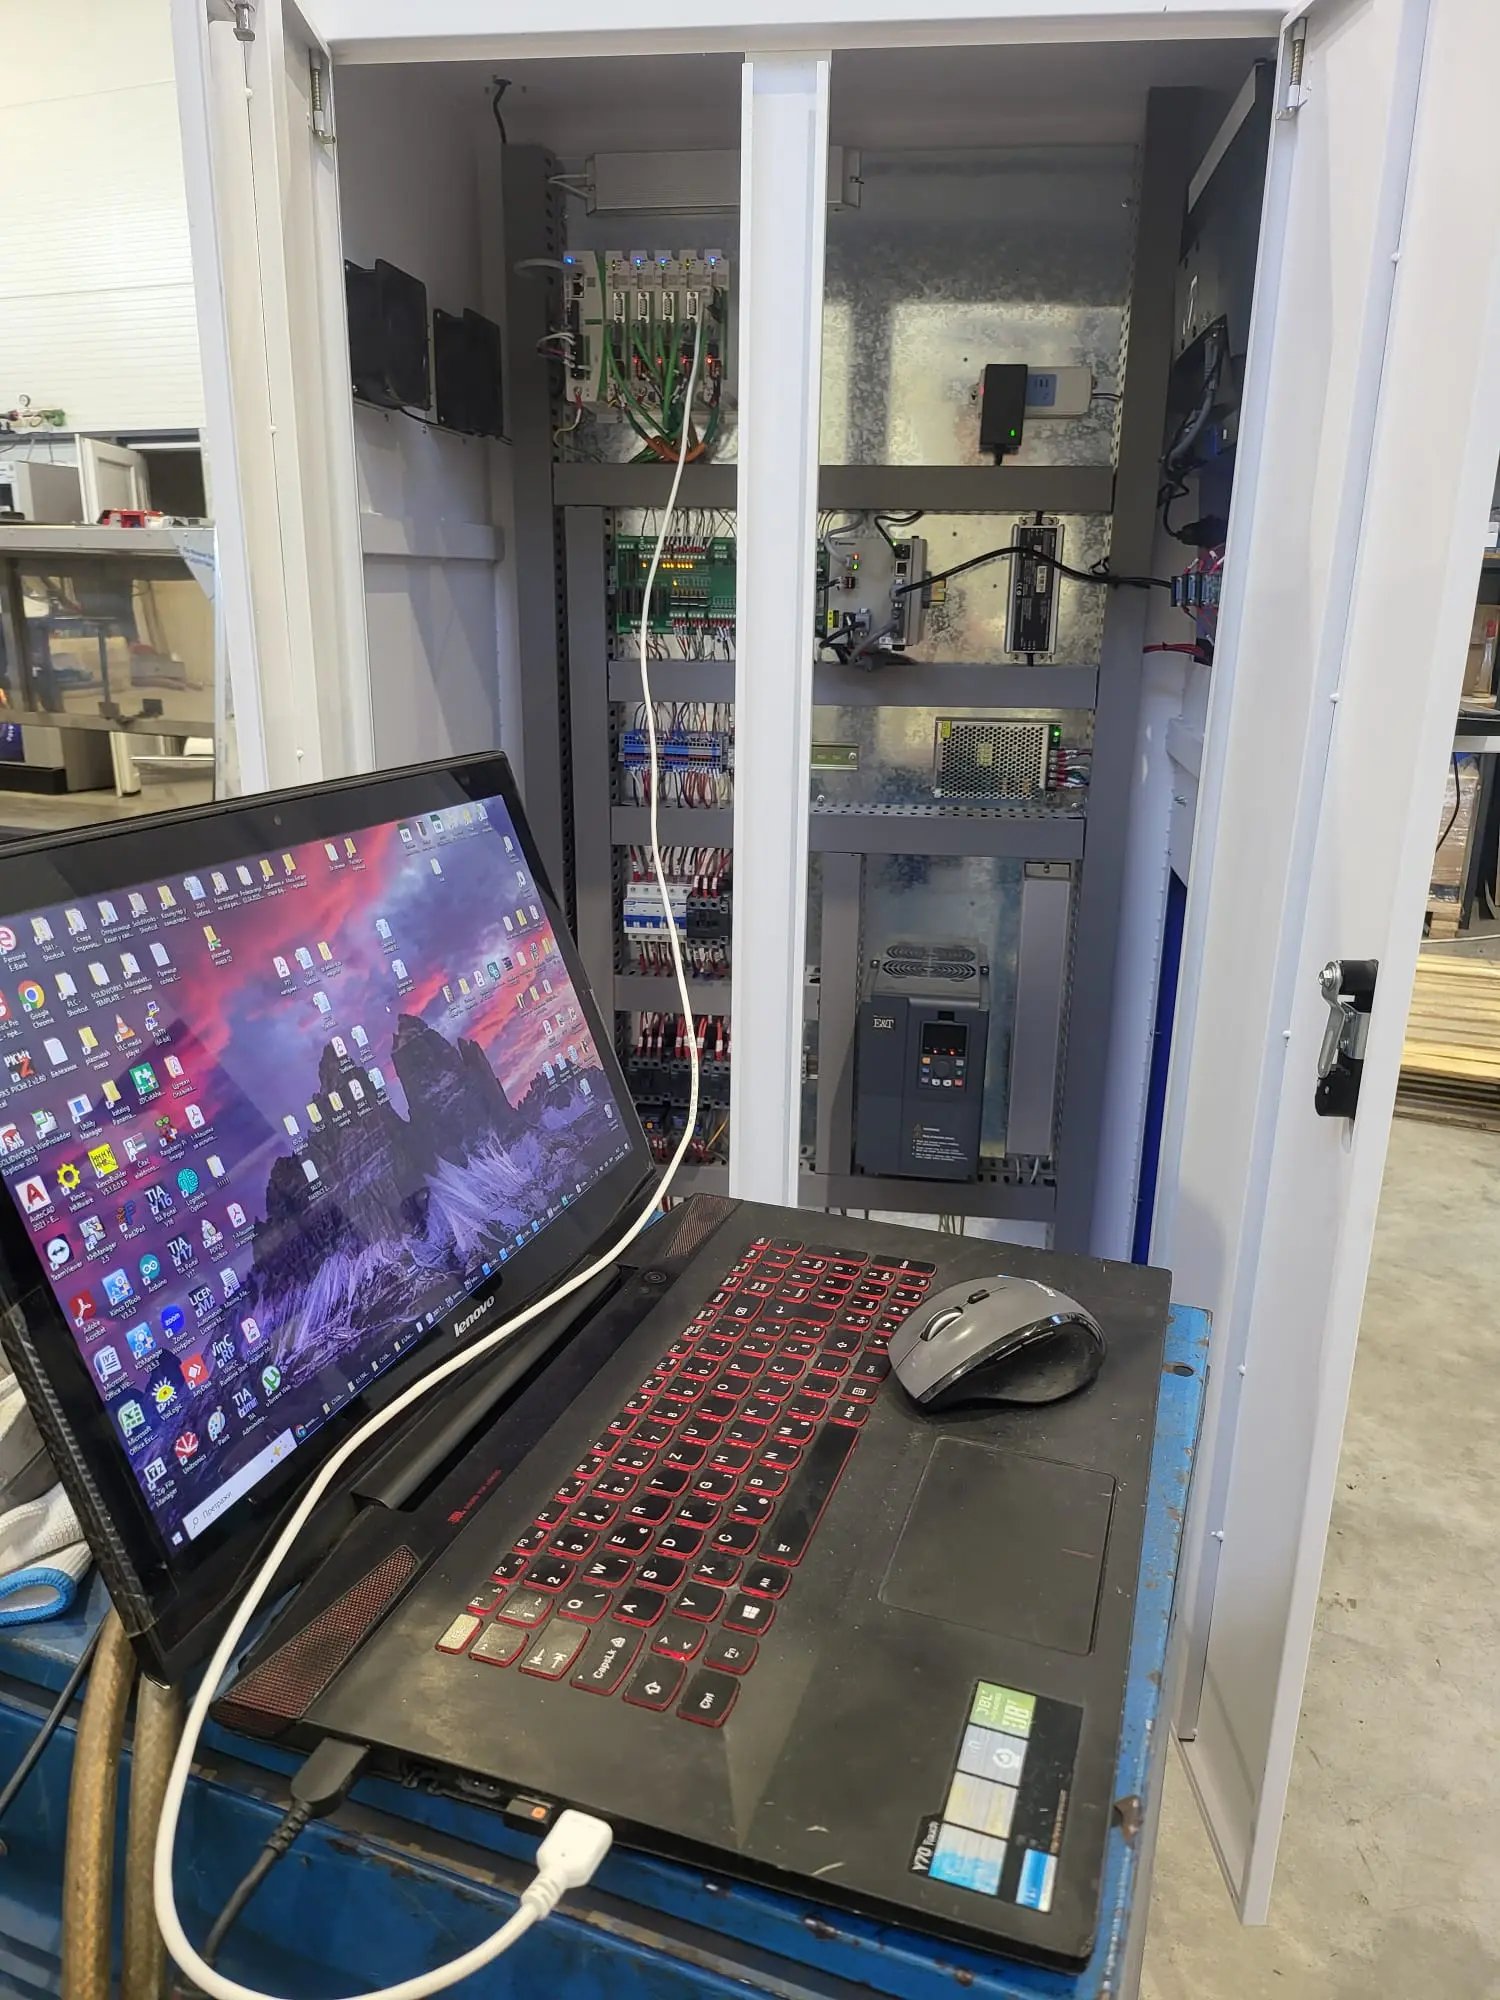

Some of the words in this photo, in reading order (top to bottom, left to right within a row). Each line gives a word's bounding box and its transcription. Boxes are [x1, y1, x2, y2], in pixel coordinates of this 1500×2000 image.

[30, 1010, 49, 1020] Google
[33, 1018, 55, 1028] Chrome
[145, 1186, 165, 1202] TIA
[29, 1206, 55, 1223] AutoCAD
[167, 1237, 188, 1255] TIA
[165, 1313, 180, 1326] zoom
[453, 1296, 495, 1337] lenovo
[669, 1344, 681, 1353] F12
[656, 1362, 667, 1370] F11
[641, 1379, 654, 1389] F10
[717, 1383, 729, 1391] O
[232, 1388, 251, 1406] TIA
[744, 1408, 758, 1416] K
[778, 1426, 793, 1435] M
[593, 1442, 604, 1450] F7
[668, 1452, 683, 1460] Z
[714, 1455, 729, 1463] H
[764, 1451, 779, 1460] N
[699, 1481, 713, 1489] G
[749, 1478, 764, 1486] B
[631, 1506, 646, 1515] R
[734, 1504, 748, 1512] V
[537, 1512, 550, 1521] F4
[680, 1509, 693, 1518] F
[611, 1535, 626, 1544] E
[661, 1538, 676, 1547] D
[718, 1533, 733, 1543] C
[516, 1538, 529, 1548] F3
[570, 1543, 584, 1552] 3
[494, 1566, 508, 1576] F2
[589, 1562, 607, 1574] W
[699, 1564, 715, 1575] X
[642, 1570, 658, 1579] S
[547, 1576, 561, 1585] 2
[469, 1596, 484, 1607] F1
[567, 1599, 584, 1609] Q
[680, 1597, 696, 1606] Y
[622, 1604, 638, 1614] A
[724, 1647, 740, 1659] Fn
[592, 1648, 617, 1679] CapsLk
[699, 1692, 715, 1709] Ctrl
[912, 1845, 932, 1871] Y70
